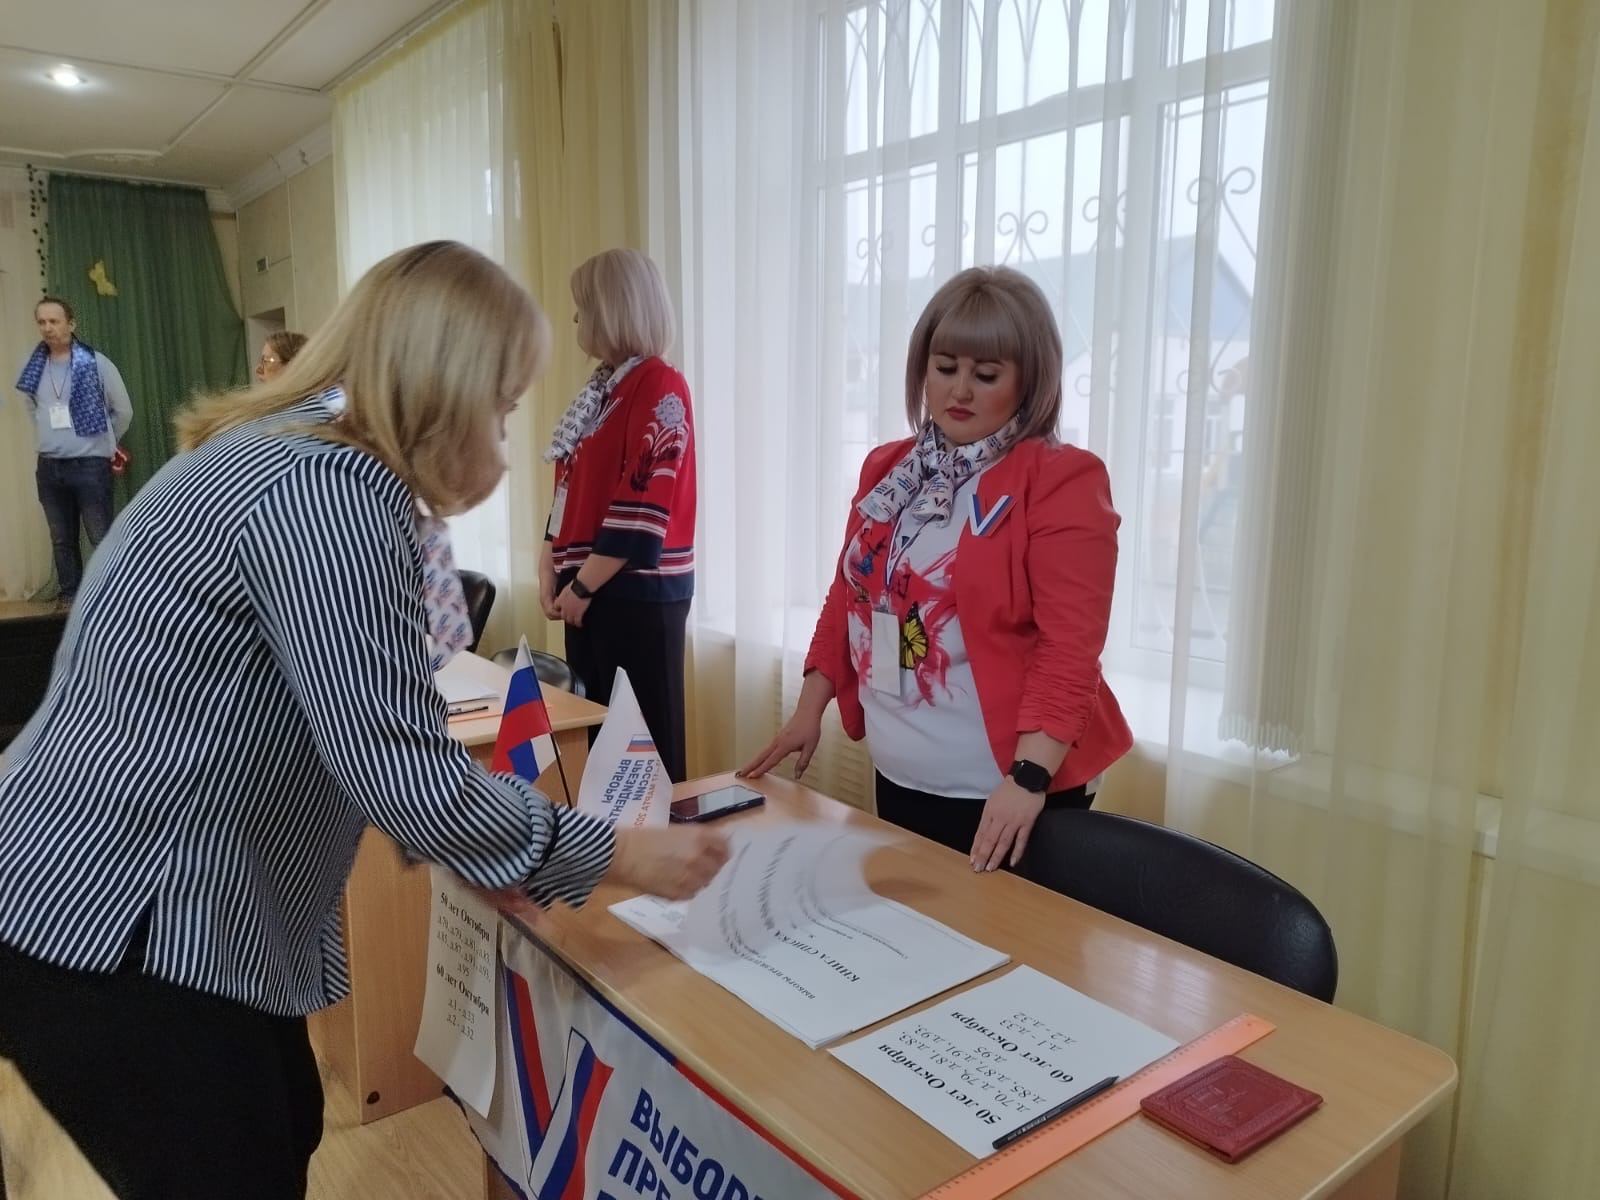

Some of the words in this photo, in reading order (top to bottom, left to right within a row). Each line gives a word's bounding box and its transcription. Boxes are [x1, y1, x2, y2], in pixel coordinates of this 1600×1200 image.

[436, 963, 445, 977] 60
[459, 980, 490, 1016] Октября
[951, 1011, 1018, 1052] Октября
[878, 1043, 946, 1089] Октября
[1020, 1052, 1052, 1068] лет
[1049, 1069, 1074, 1083] 60
[945, 1089, 979, 1108] лет
[975, 1109, 1002, 1125] 50
[630, 1088, 766, 1200] ВЫБОР
